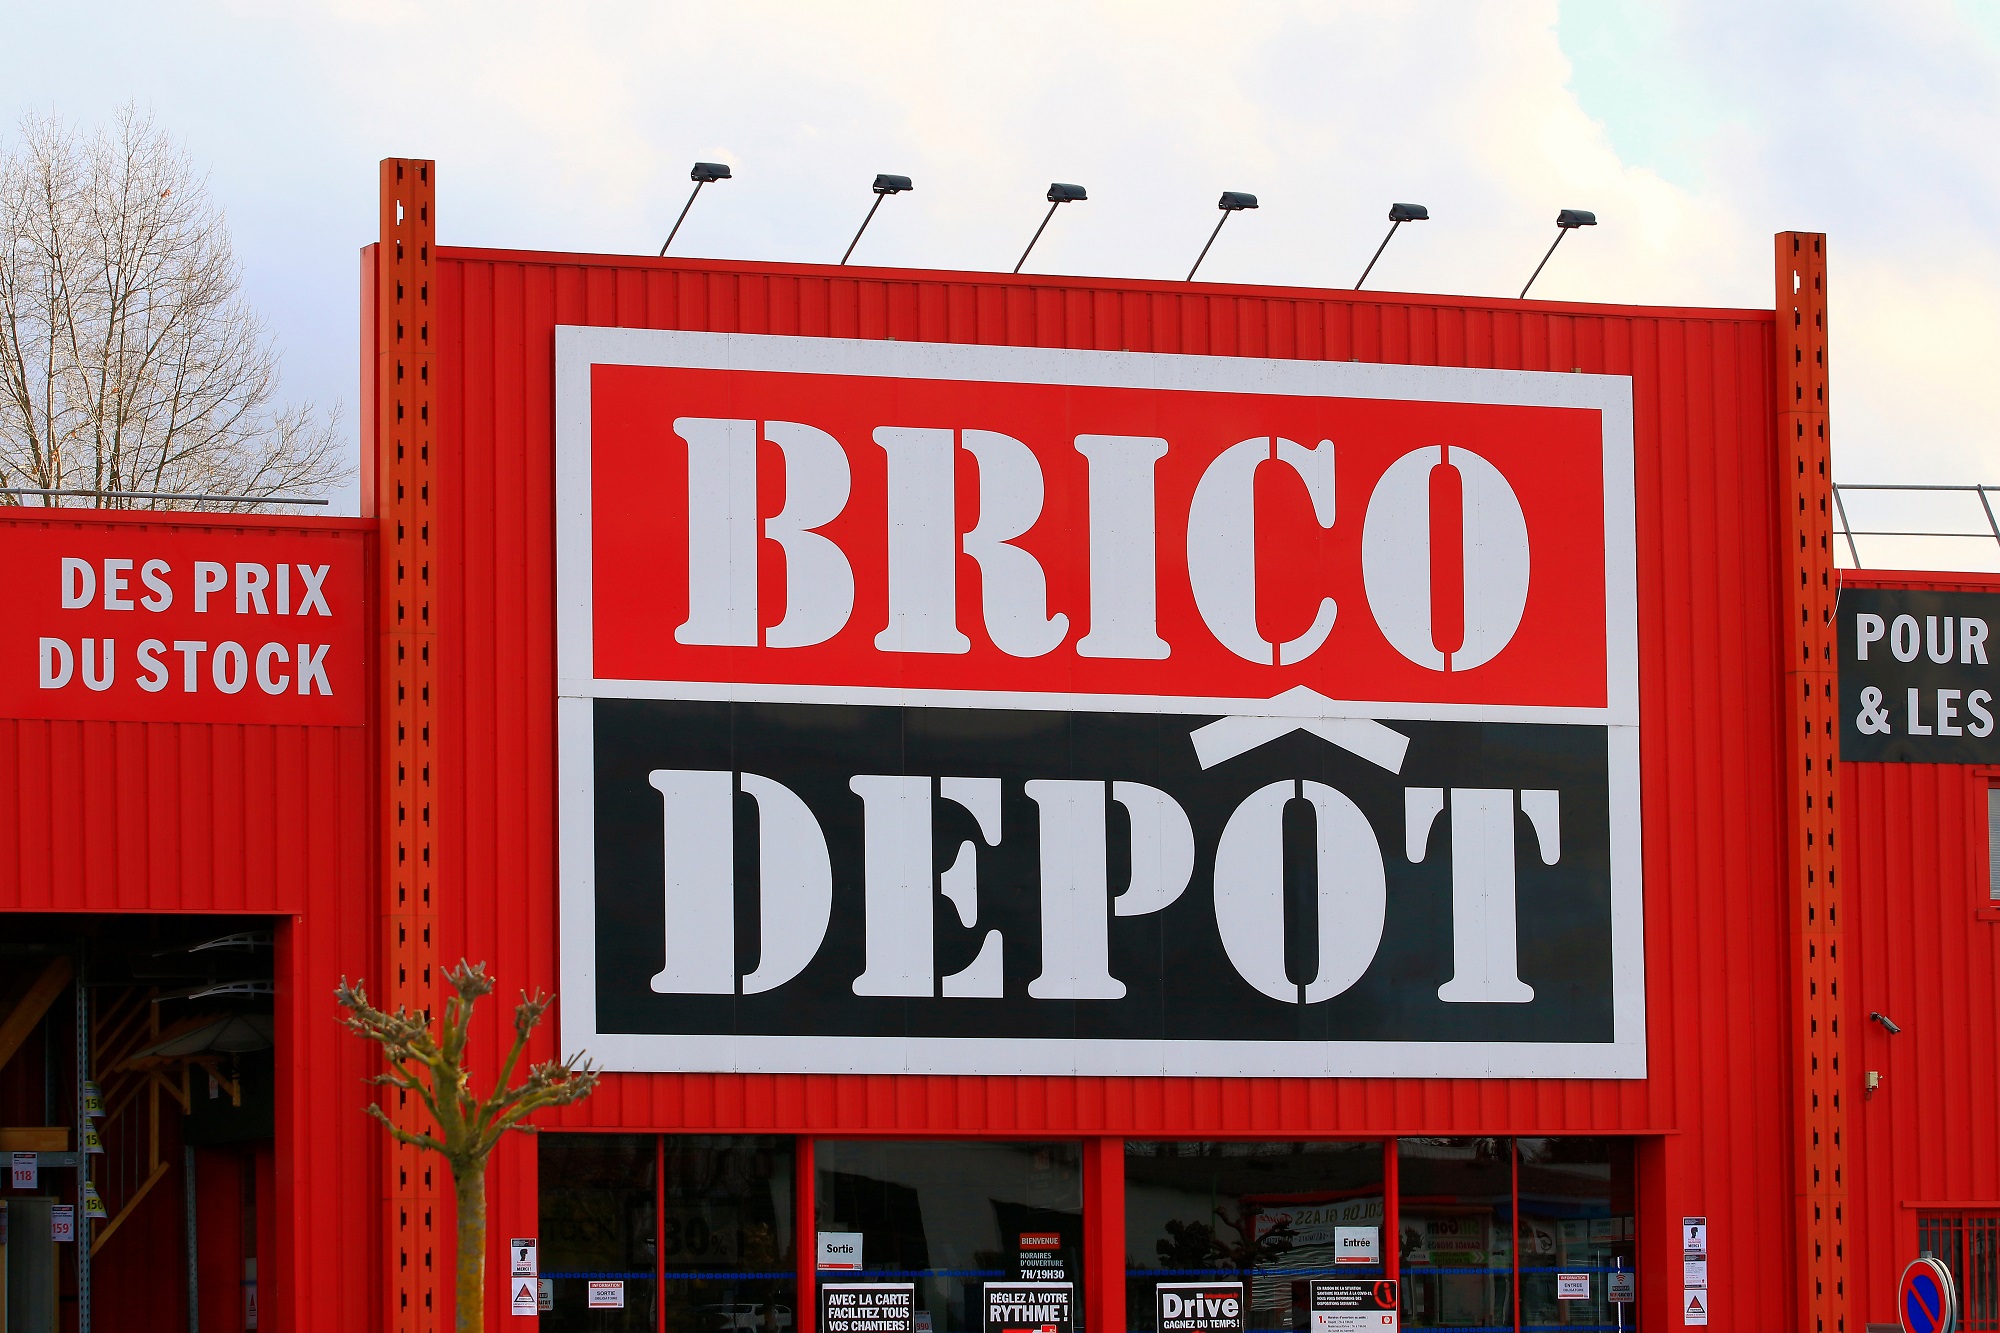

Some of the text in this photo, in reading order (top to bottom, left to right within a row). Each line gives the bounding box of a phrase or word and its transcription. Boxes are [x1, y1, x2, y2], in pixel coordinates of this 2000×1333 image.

[673, 416, 1531, 673] BRICO
[61, 557, 332, 616] DES PRIX
[1856, 613, 1989, 665] POUR
[39, 637, 333, 696] DU STOCK
[1855, 686, 1994, 738] & LES
[648, 685, 1562, 1006] DEPÔT
[1021, 1237, 1059, 1245] BIENVENUE
[1343, 1238, 1371, 1248] Entrée
[826, 1244, 854, 1253] Sortie
[1020, 1269, 1065, 1279] 7H/19H30
[828, 1294, 910, 1305] AVEC LA CARTE
[990, 1292, 1069, 1304] RÉGLEZ À VOTRE
[1163, 1293, 1239, 1318] Drive
[828, 1307, 910, 1318] FACILITEZ TOUS
[828, 1320, 849, 1331] VOS
[1163, 1320, 1196, 1329] GAGNEZ
[1197, 1320, 1208, 1328] DU
